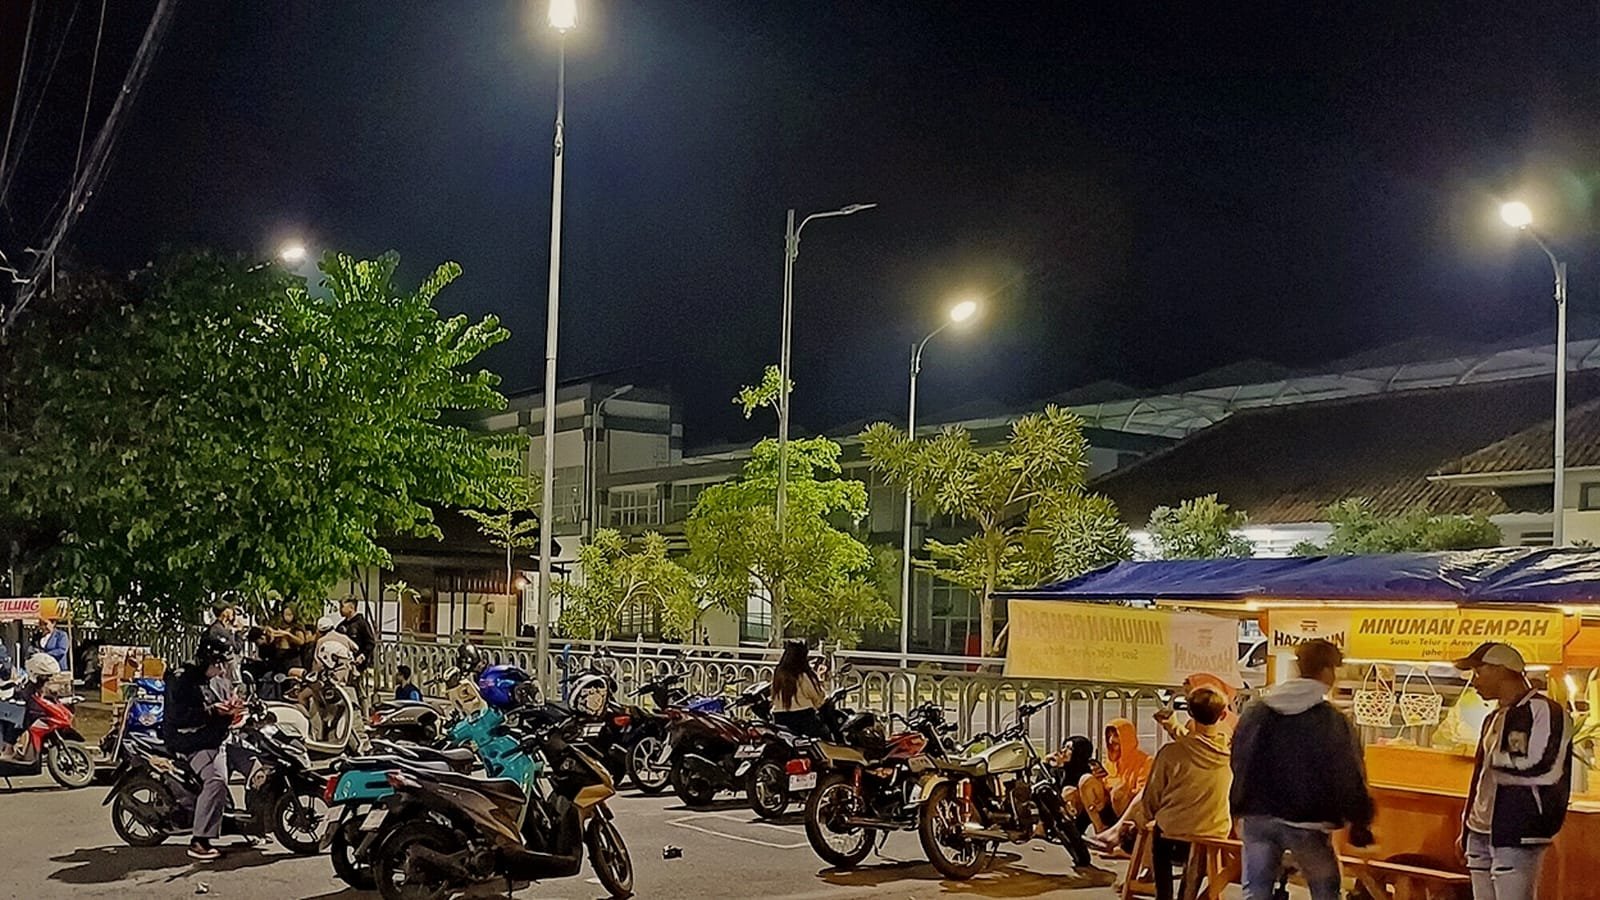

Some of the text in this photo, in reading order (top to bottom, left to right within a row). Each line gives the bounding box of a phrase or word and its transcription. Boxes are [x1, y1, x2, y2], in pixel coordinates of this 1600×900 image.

[1358, 618, 1550, 636] MINUMAN REMPAH
[1389, 637, 1410, 646] Susu
[1419, 638, 1441, 646] Telur
[1450, 638, 1474, 647] Aren
